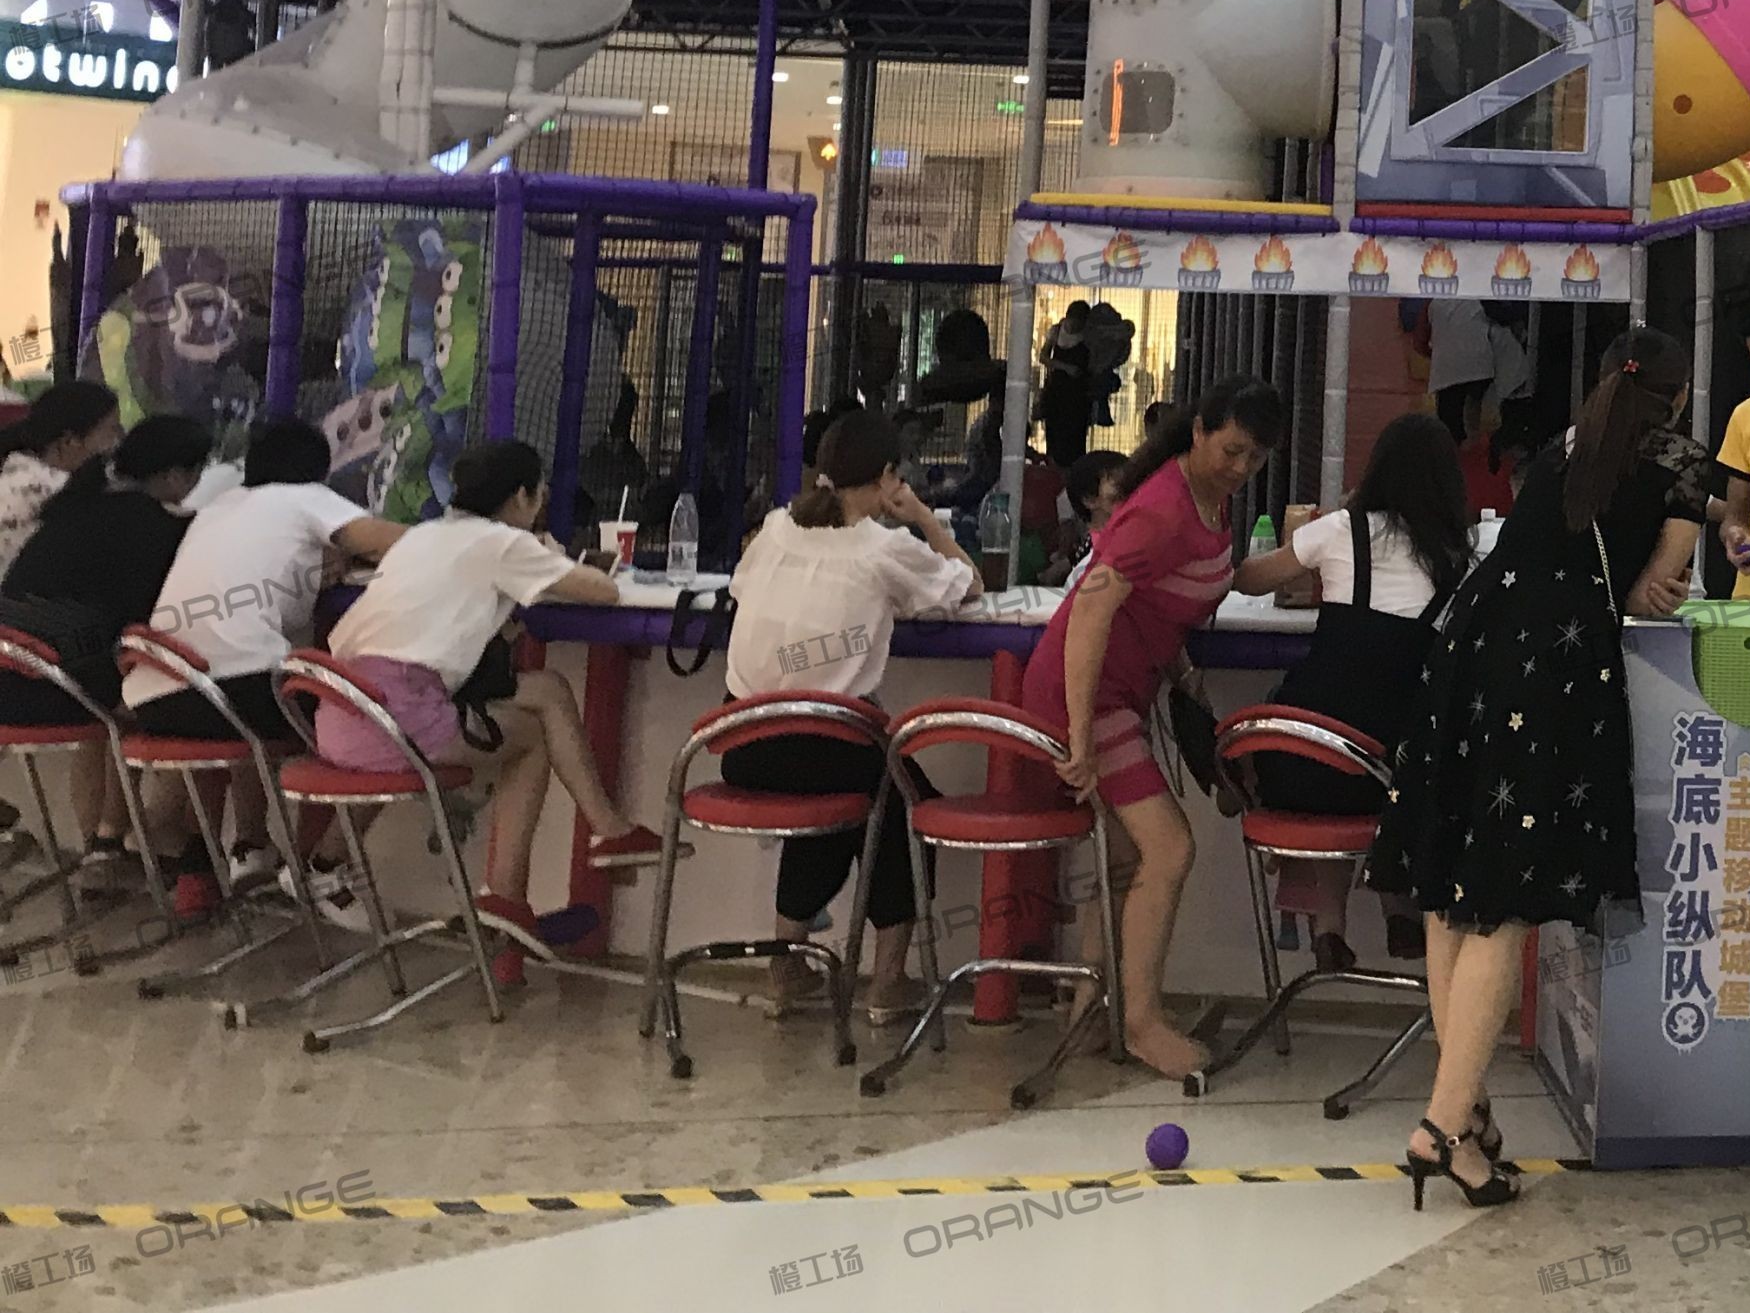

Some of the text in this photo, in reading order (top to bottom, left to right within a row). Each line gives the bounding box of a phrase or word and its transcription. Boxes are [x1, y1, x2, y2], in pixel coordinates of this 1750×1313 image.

[1665, 715, 1724, 1001] 海底小纵队
